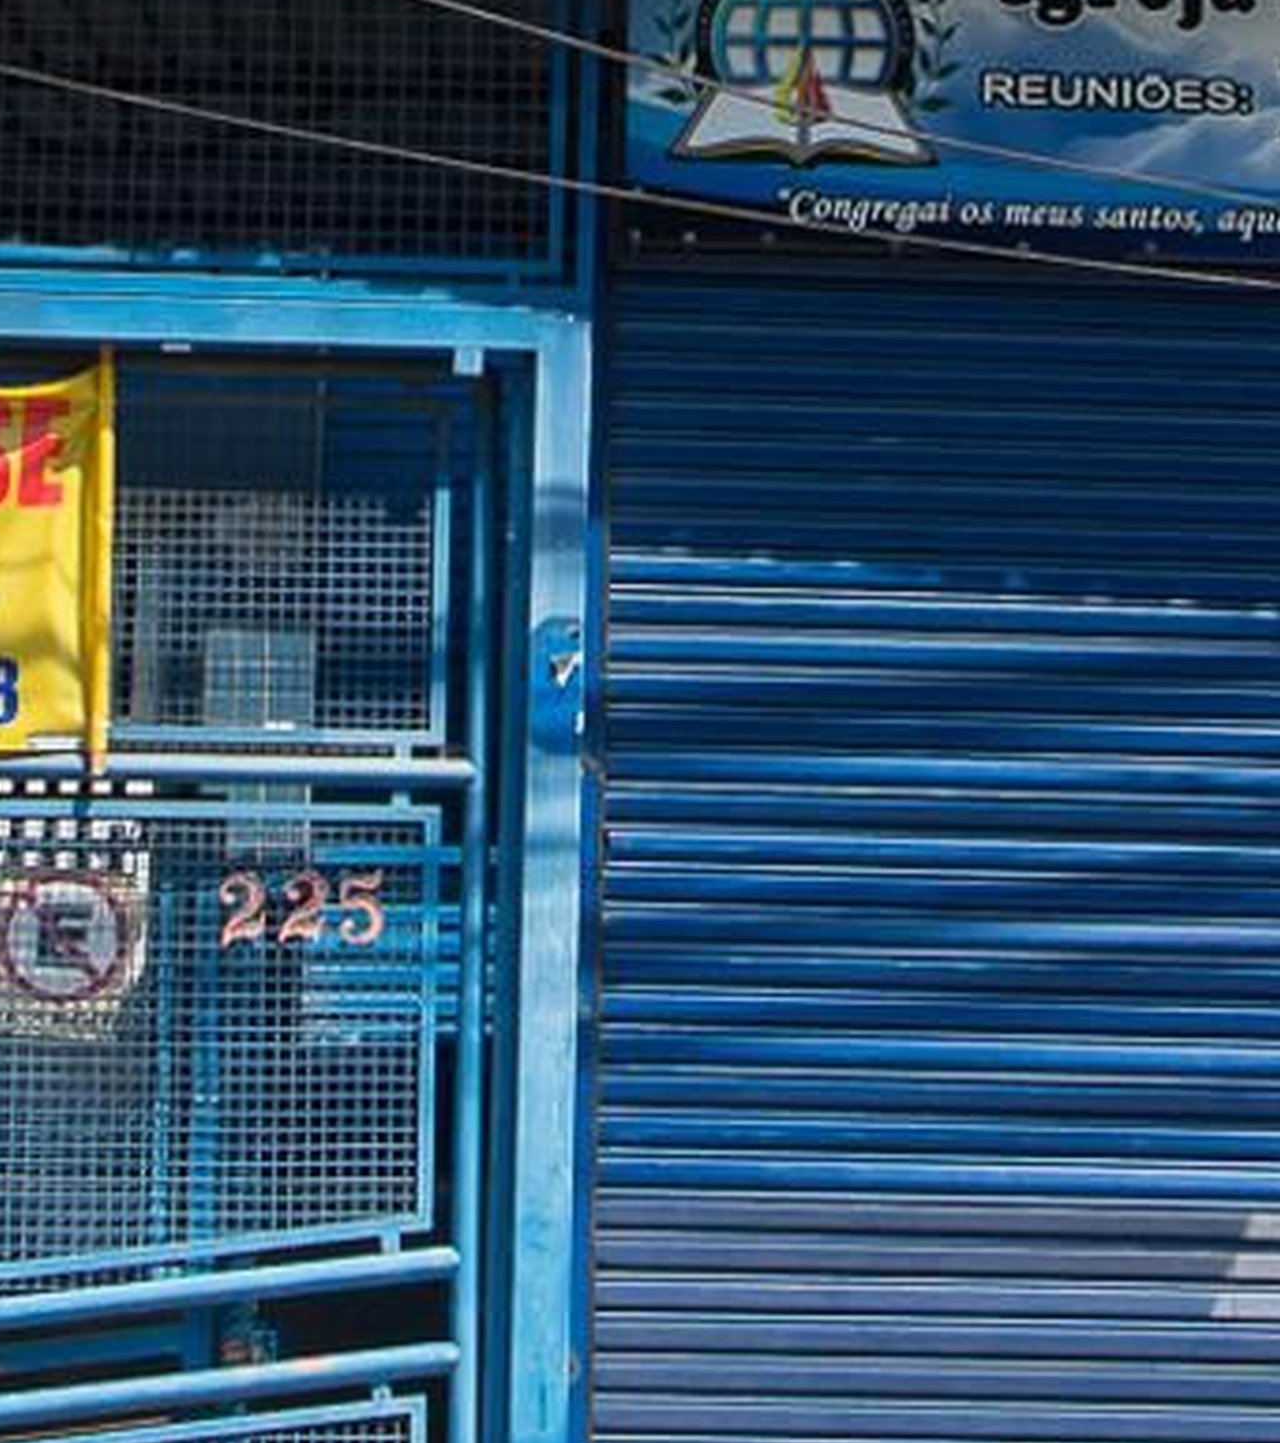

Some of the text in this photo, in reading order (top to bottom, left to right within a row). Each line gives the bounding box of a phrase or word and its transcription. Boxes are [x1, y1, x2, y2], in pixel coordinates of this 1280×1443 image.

[980, 70, 1254, 114] REUNIÕES:
[959, 201, 994, 224] os
[1005, 204, 1084, 228] meus
[219, 869, 386, 951] 225
